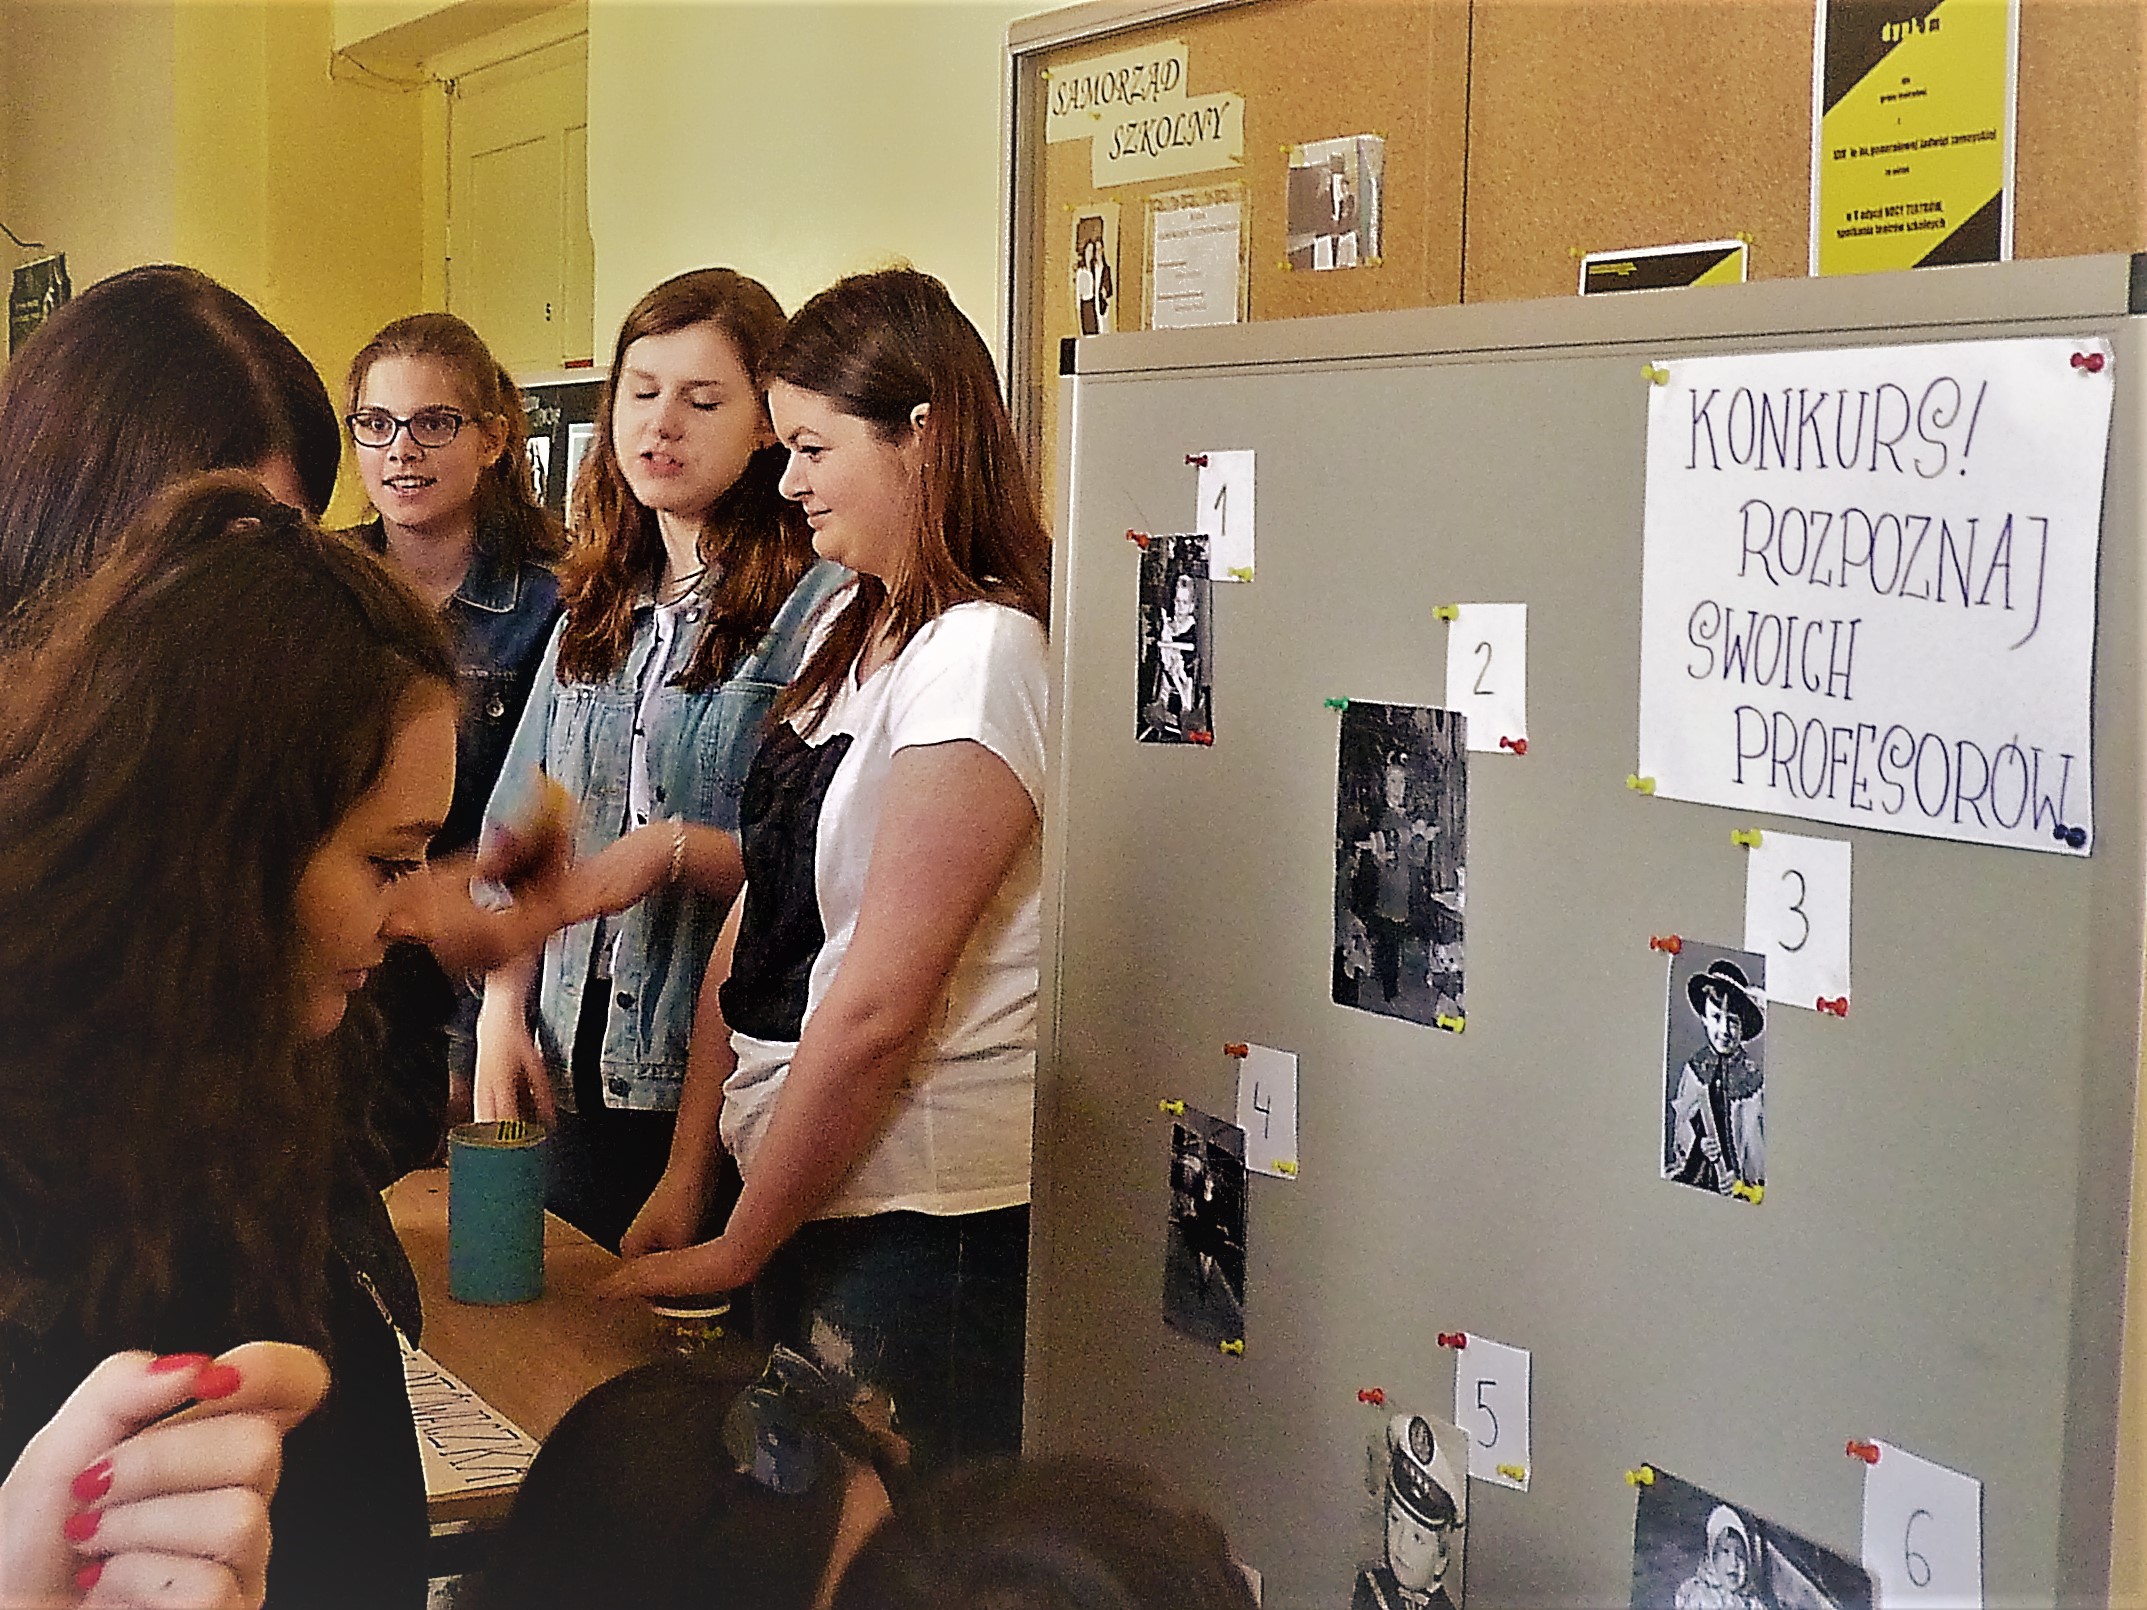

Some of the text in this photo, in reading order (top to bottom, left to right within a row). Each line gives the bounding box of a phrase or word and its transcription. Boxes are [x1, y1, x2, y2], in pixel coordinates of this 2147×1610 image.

[1108, 101, 1231, 161] SZKOLNY
[1685, 376, 1988, 479] KONKURS!
[1213, 483, 1228, 537] 1
[1737, 498, 2049, 650] ROZPOZNAJ
[1472, 640, 1496, 696] 2
[1686, 599, 1863, 700] SWOICH
[1732, 705, 2076, 832] PROFESORÓW
[1778, 868, 1810, 953] 3
[1253, 1080, 1272, 1140] 4
[1477, 1380, 1499, 1449] 5
[1905, 1508, 1933, 1588] 6
